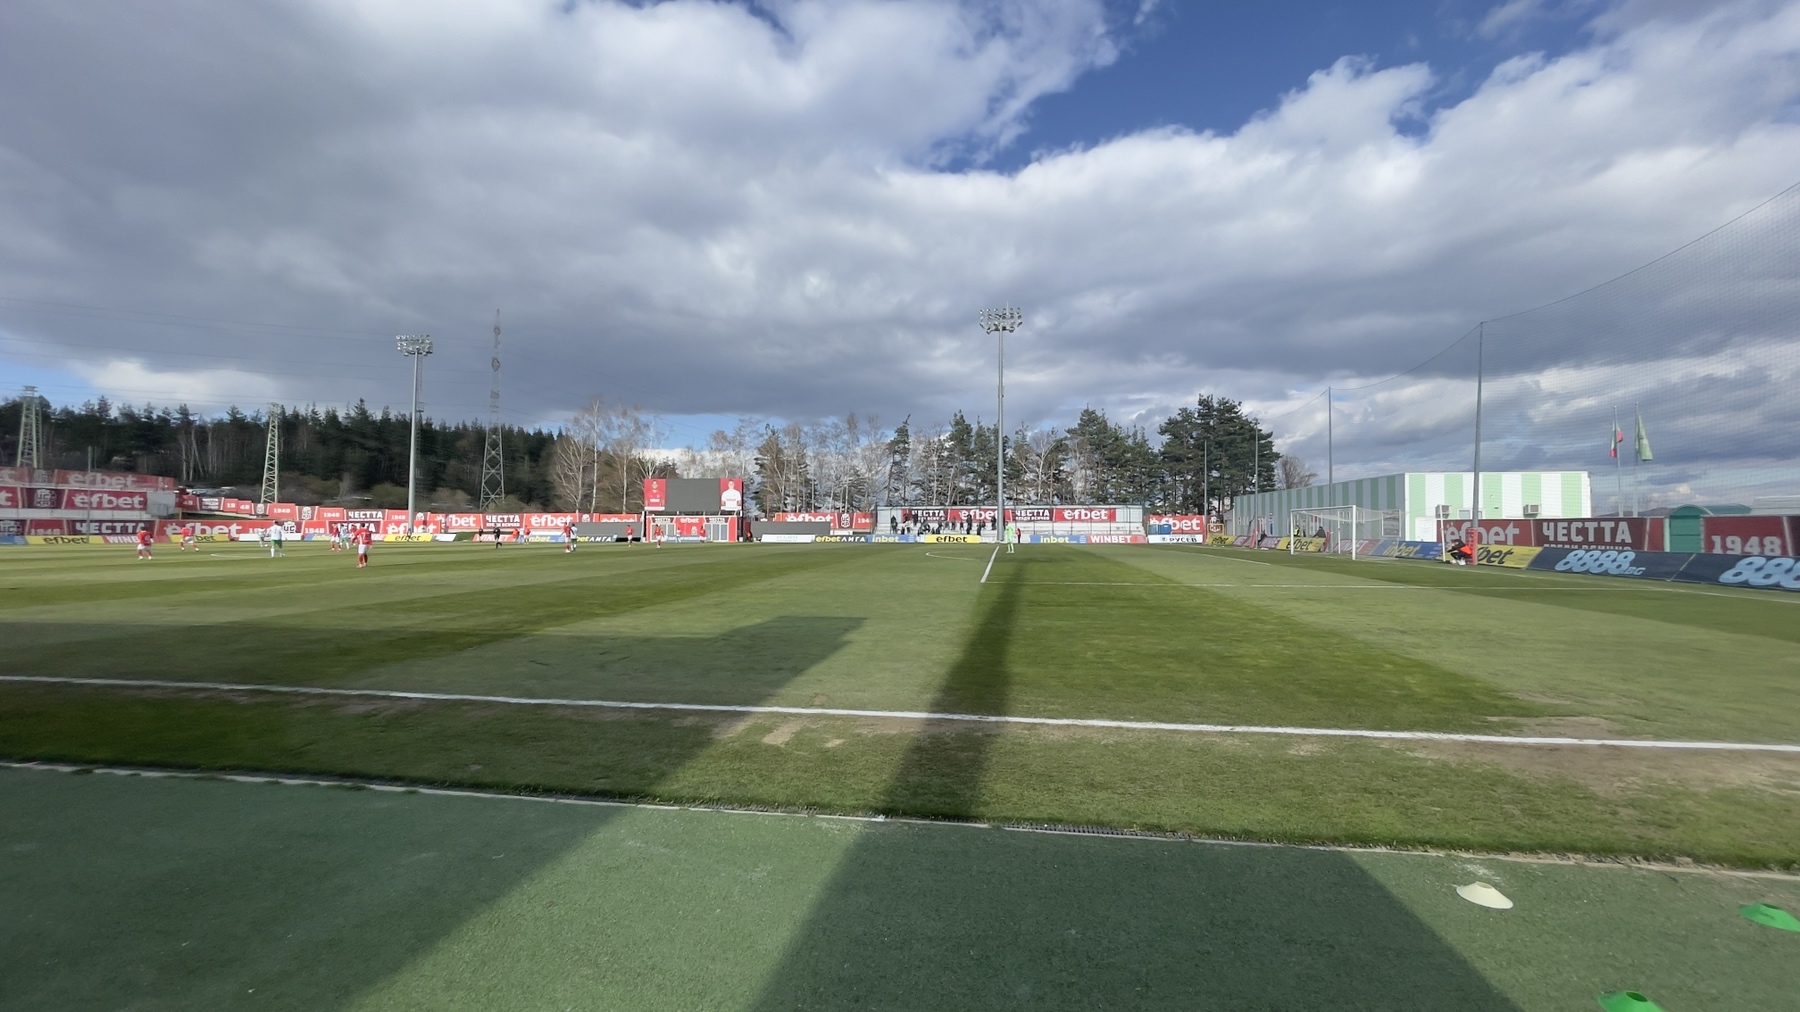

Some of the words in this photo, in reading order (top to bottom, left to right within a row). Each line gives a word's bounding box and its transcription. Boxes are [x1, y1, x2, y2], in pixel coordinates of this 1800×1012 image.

[72, 493, 144, 508] efbet
[1015, 509, 1050, 517] ЧЕСТТА
[1062, 508, 1109, 520] efbet
[486, 515, 520, 523] ЧЕСТТА
[530, 514, 573, 527] efbet
[1542, 521, 1632, 543] ЧЕСТТА
[43, 536, 89, 544] efbet
[936, 535, 968, 543] efbet
[1090, 535, 1132, 543] WINBET
[1711, 535, 1782, 555] 1948
